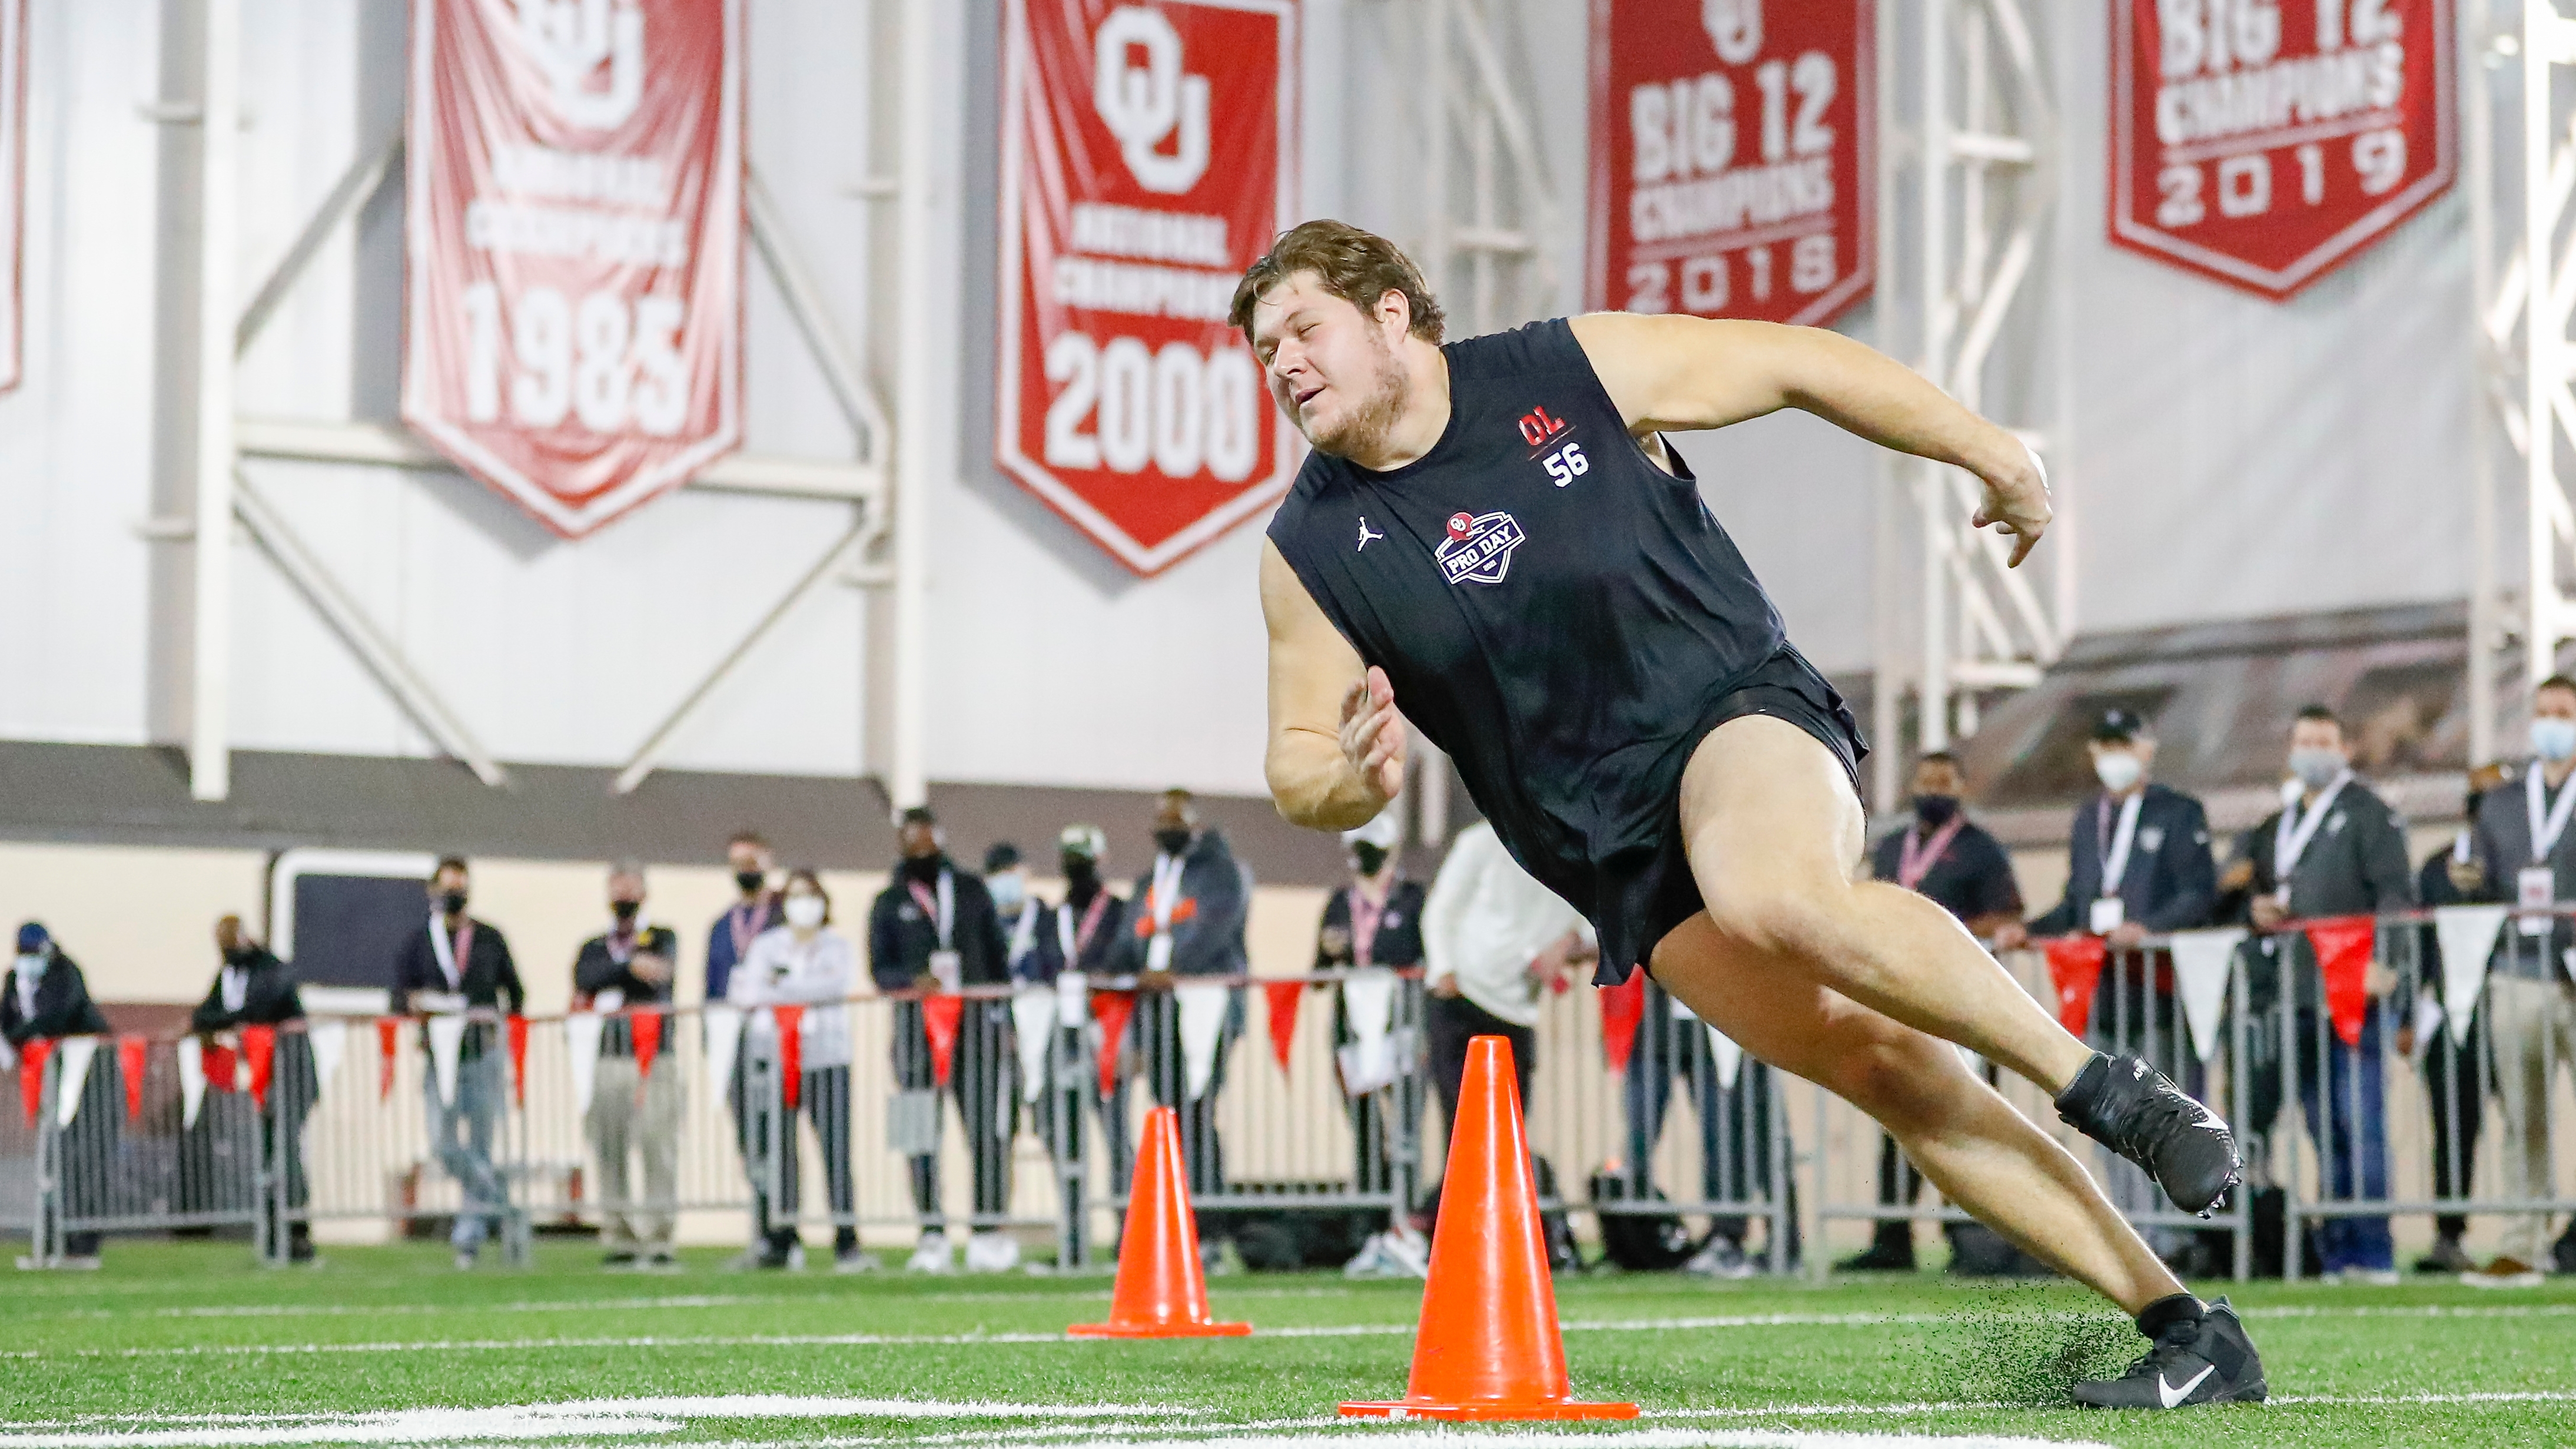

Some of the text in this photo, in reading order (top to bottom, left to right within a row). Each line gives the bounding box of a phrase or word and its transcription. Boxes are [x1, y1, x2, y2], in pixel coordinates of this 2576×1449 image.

[1095, 6, 1210, 194] OU
[1631, 51, 1835, 183] BIG 12
[2155, 128, 2408, 228] 2019
[1626, 234, 1836, 315] 2018
[464, 281, 689, 436] 1985
[1043, 329, 1259, 483] 2000
[1518, 405, 1566, 446] OL
[1542, 442, 1589, 488] 56
[1446, 526, 1512, 574] PRO DAY
[1450, 518, 1466, 532] OU
